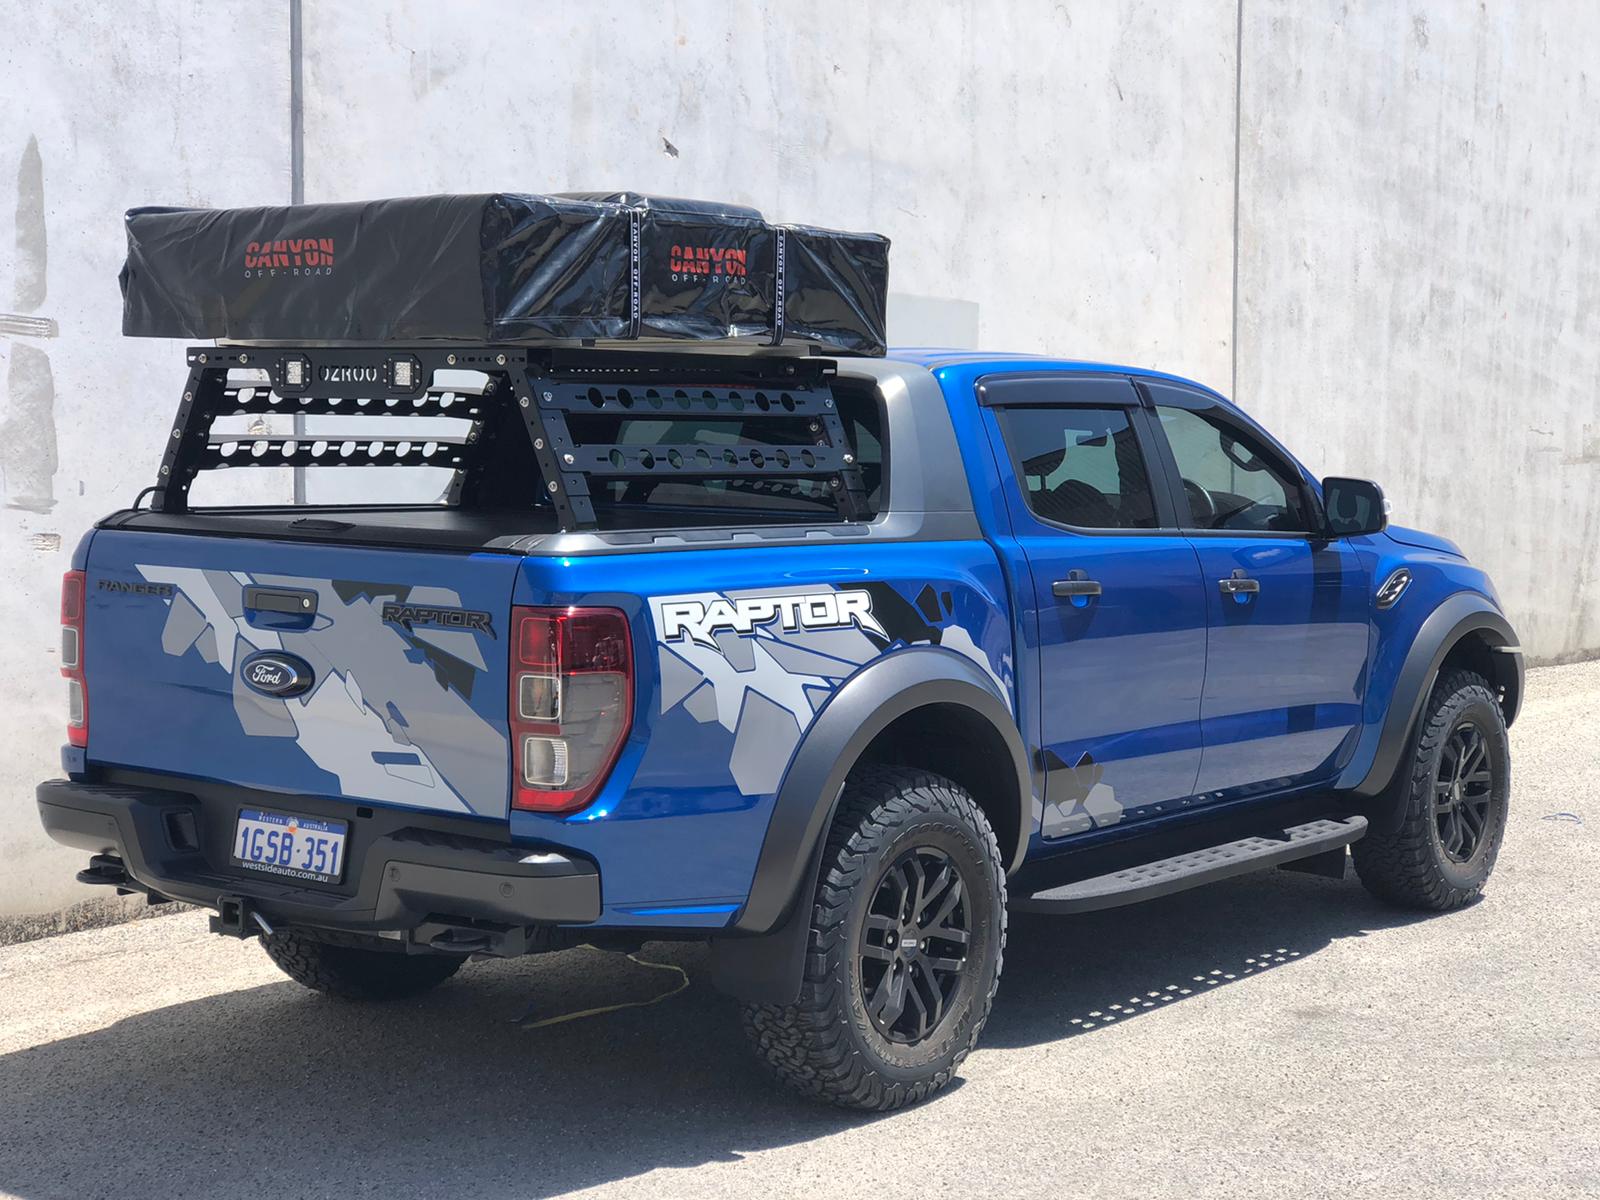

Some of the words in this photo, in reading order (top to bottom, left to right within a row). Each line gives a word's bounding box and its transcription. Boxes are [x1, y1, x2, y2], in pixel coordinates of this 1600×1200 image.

[244, 238, 334, 268] CANYON
[670, 245, 747, 275] CANYON
[244, 267, 333, 278] OFF-ROAD
[671, 274, 746, 285] OFF-ROAD
[96, 580, 174, 597] RANGER
[383, 605, 497, 640] RAPTOR
[660, 591, 892, 656] RAPTOR
[252, 664, 282, 684] Ford
[242, 861, 328, 882] westsideauto.com.au
